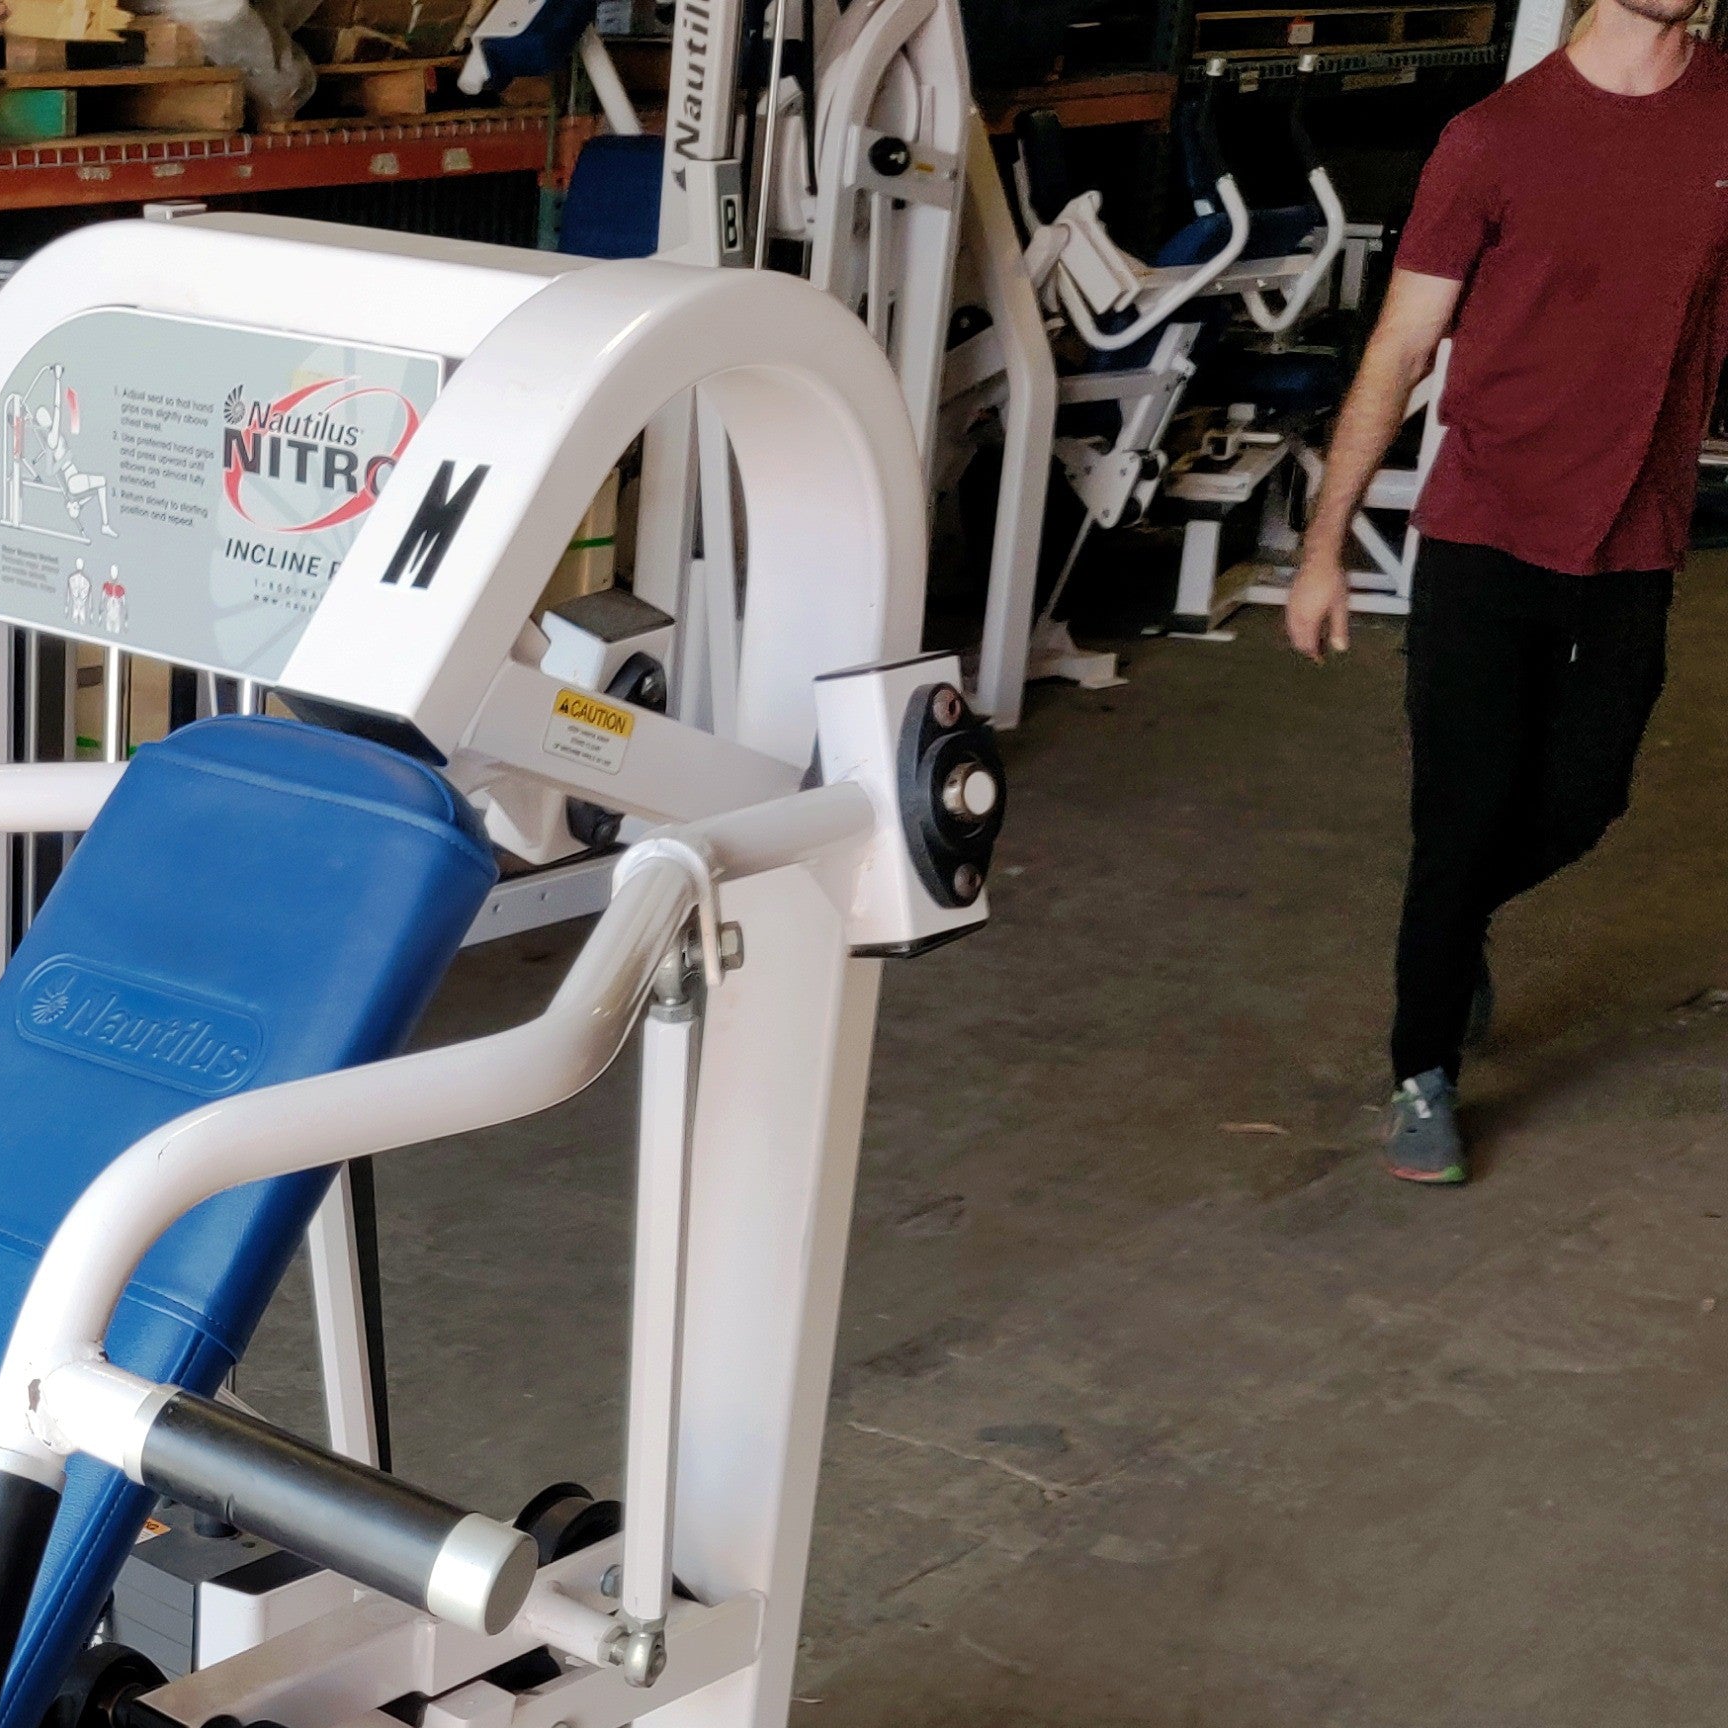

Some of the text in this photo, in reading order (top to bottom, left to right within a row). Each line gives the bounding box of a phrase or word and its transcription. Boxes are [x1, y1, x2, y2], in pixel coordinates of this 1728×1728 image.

[674, 0, 710, 160] Nautil
[248, 401, 359, 446] Nautilus
[225, 538, 322, 578] INCLINE
[571, 700, 626, 733] CAUTION
[64, 989, 247, 1079] Nautilus
